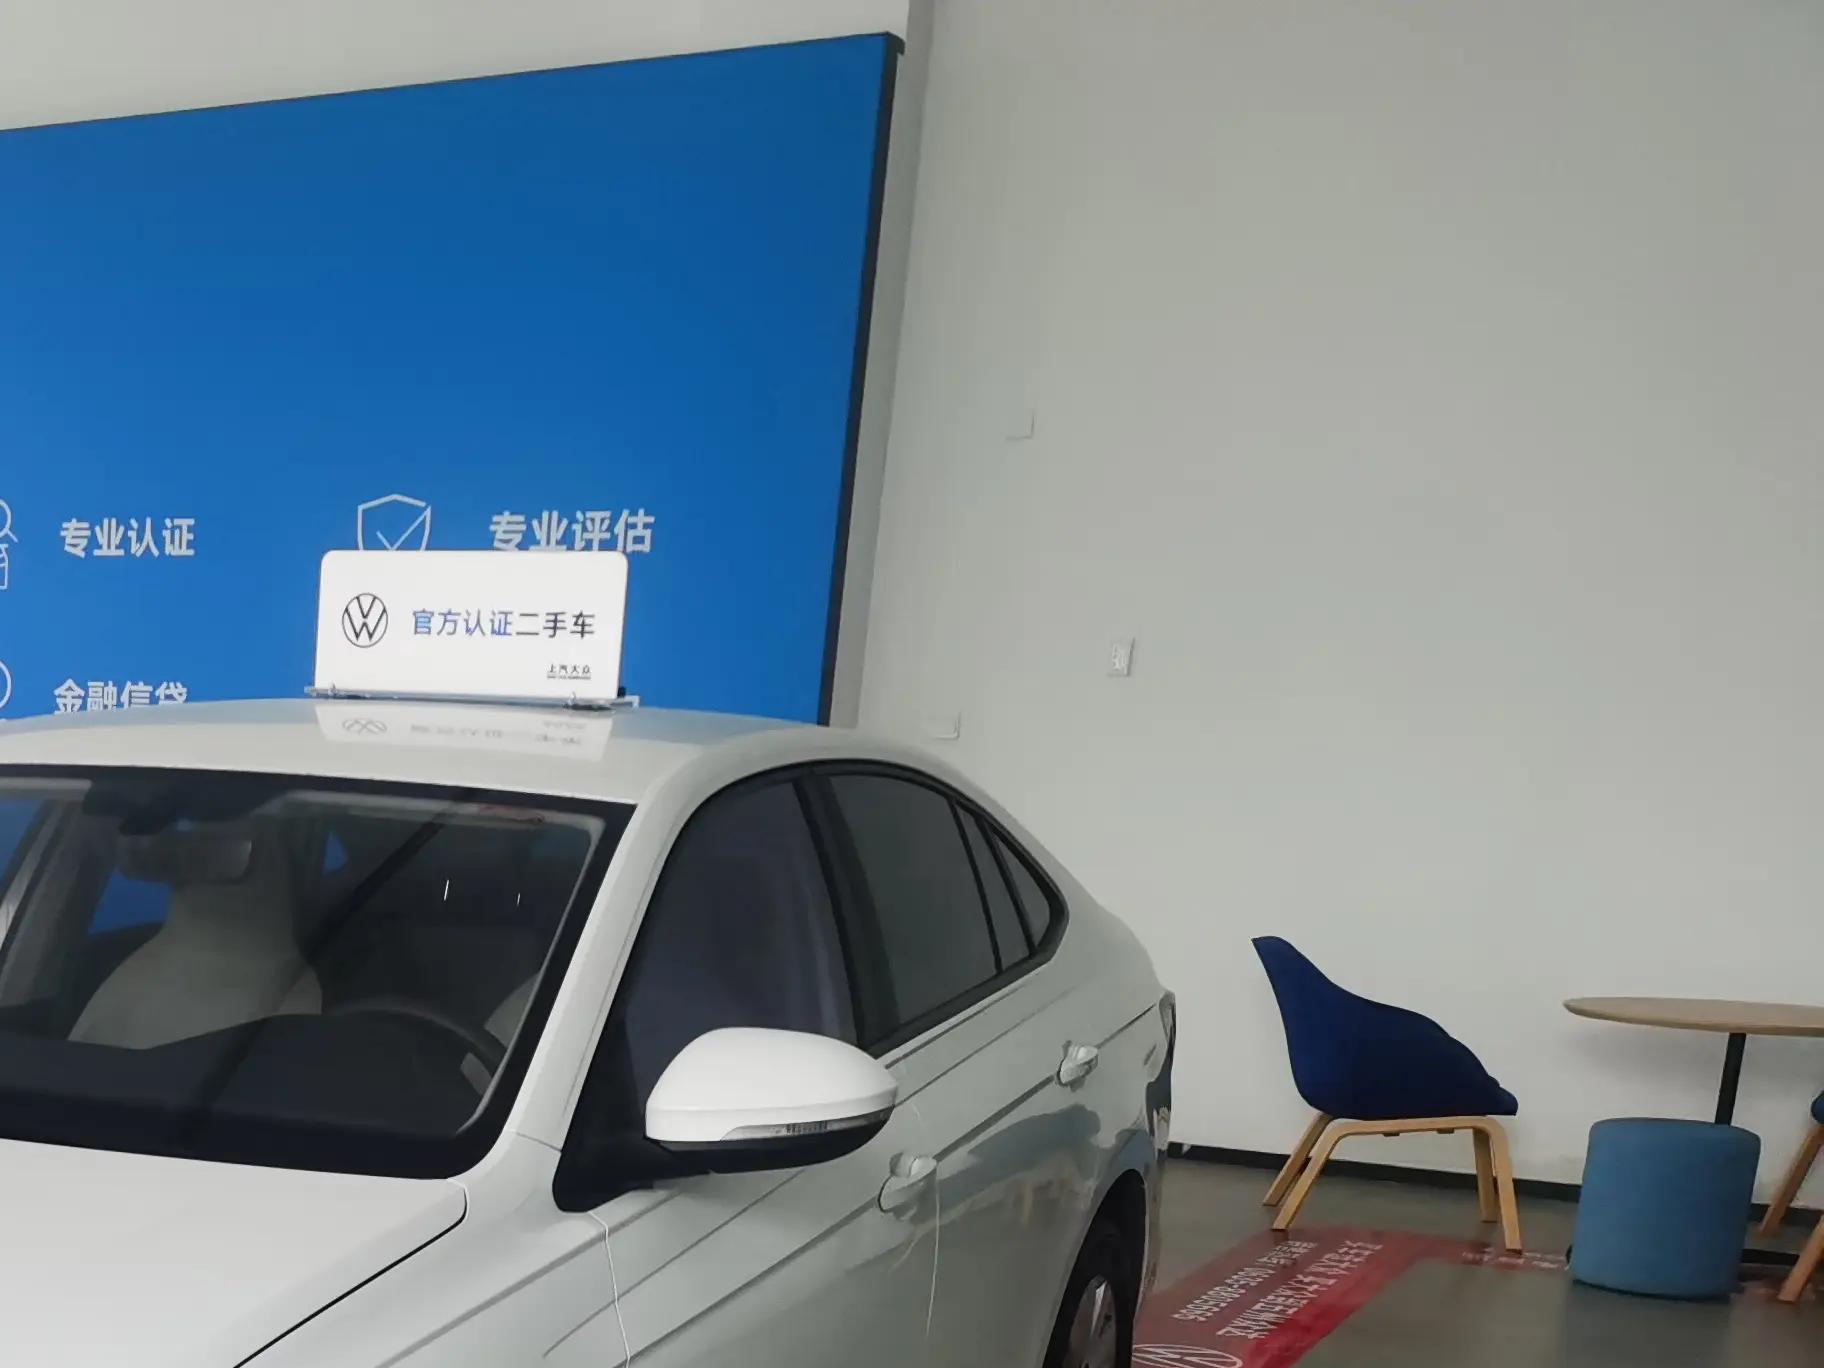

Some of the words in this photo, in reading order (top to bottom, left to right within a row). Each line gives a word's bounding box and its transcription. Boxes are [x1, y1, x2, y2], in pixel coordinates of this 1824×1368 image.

[60, 516, 195, 558] 专业认证
[489, 508, 655, 552] 专业评估
[412, 608, 595, 638] 官方认证二手车
